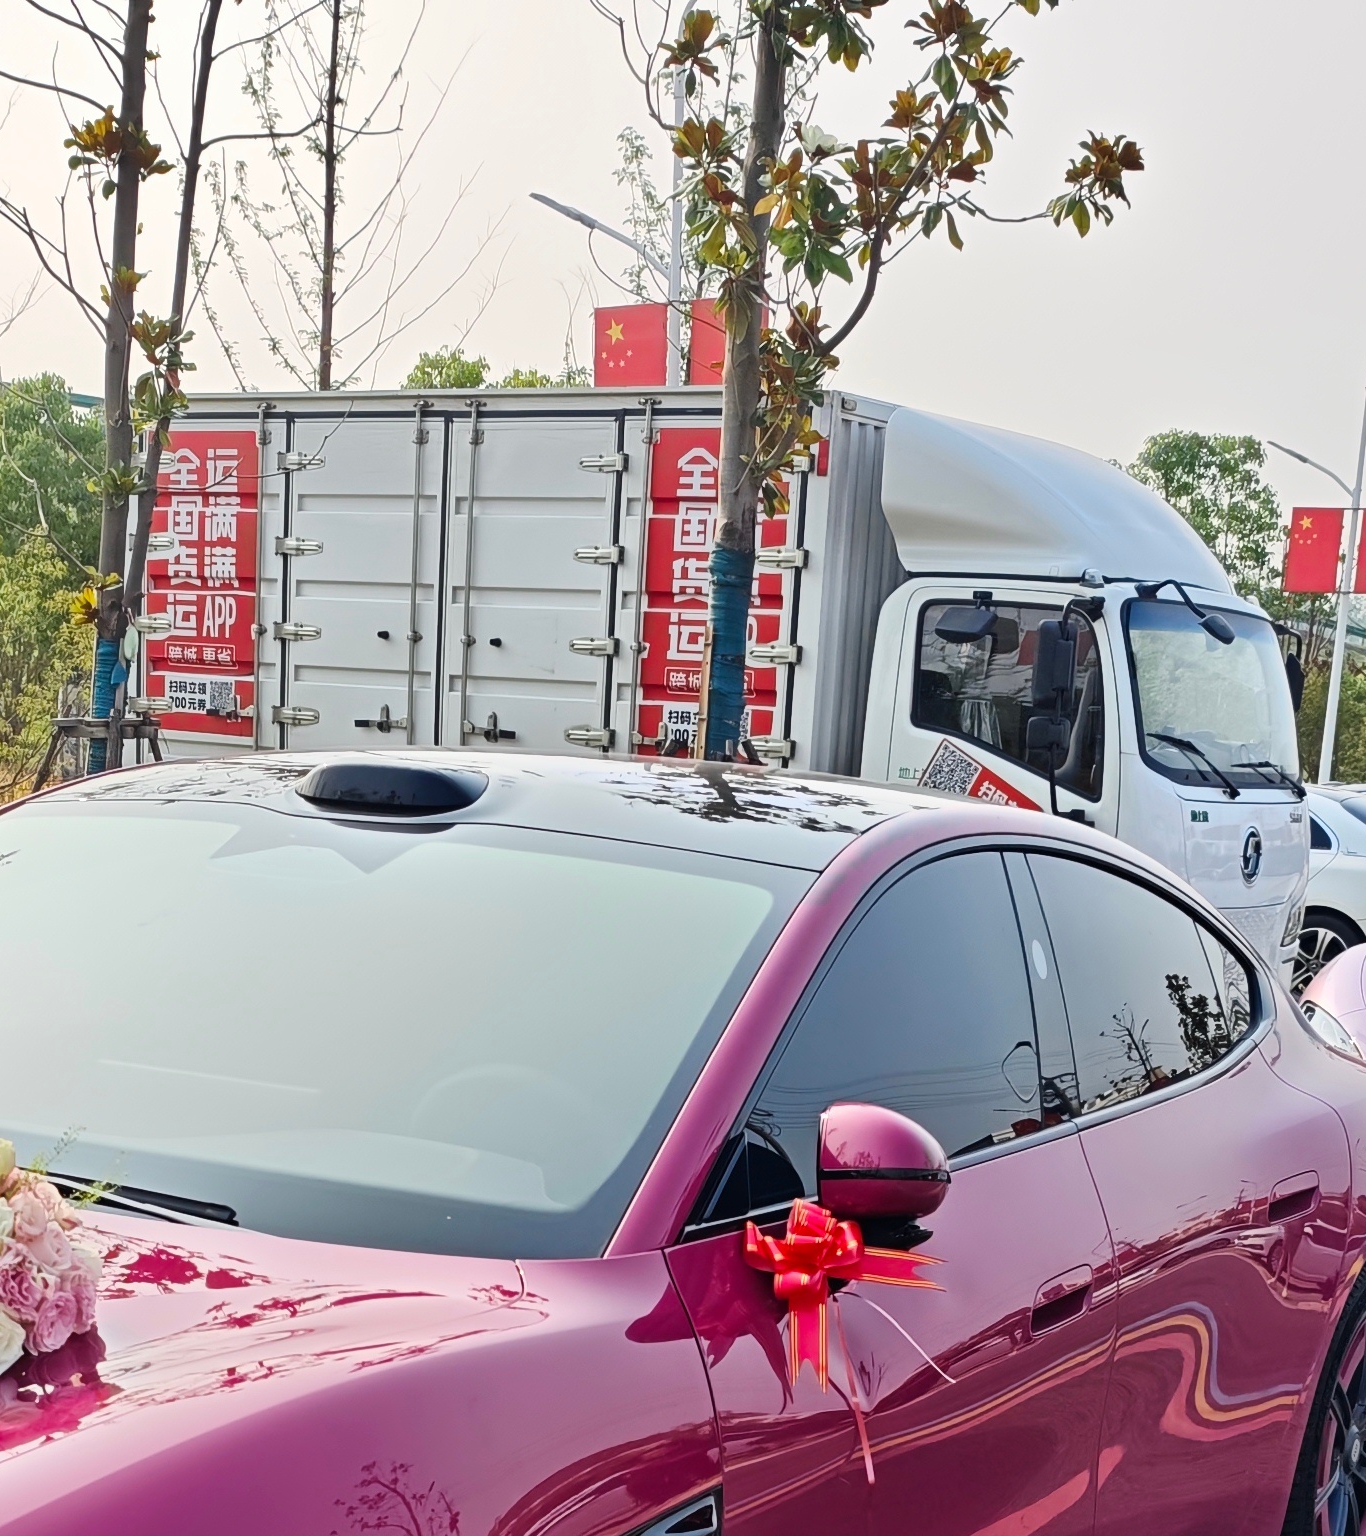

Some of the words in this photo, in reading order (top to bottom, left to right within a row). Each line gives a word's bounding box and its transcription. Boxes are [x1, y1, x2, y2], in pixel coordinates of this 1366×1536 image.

[165, 448, 202, 638] 全国货运
[667, 447, 719, 660] 全国货运
[169, 680, 207, 695] 扫码立领
[898, 766, 926, 780] 地上
